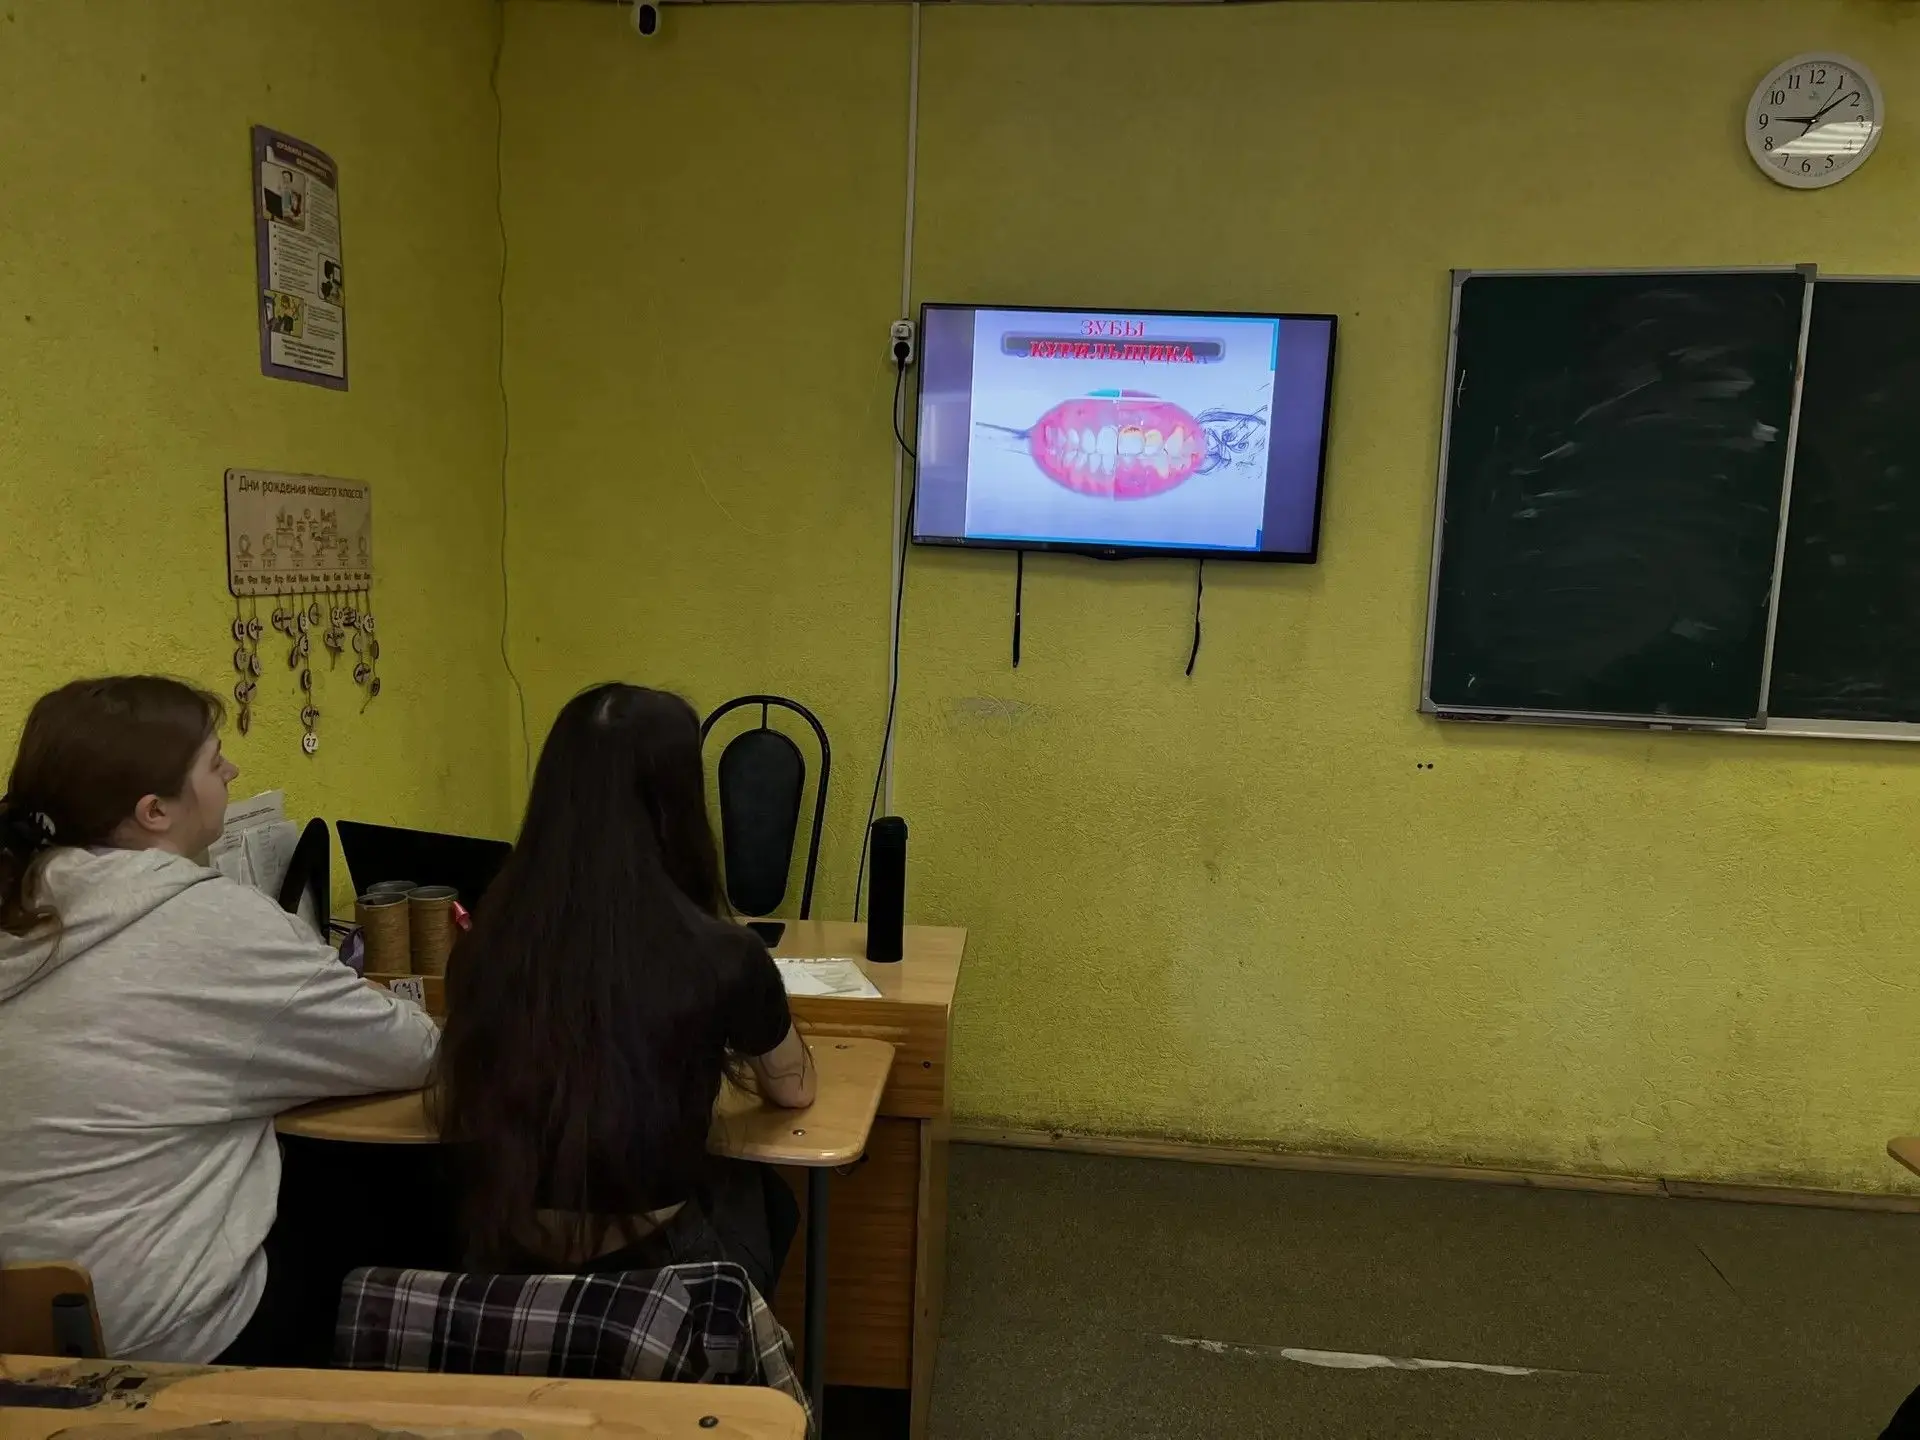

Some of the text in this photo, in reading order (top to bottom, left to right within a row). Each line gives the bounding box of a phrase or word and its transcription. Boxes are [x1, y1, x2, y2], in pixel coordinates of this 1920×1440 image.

[1788, 74, 1801, 90] 11
[1808, 69, 1826, 85] 12
[1838, 74, 1845, 90] 1
[1769, 90, 1786, 106] 10
[1849, 90, 1861, 107] 2
[1759, 113, 1769, 130] 9
[1764, 135, 1774, 151] 8
[1780, 152, 1790, 168] 7
[1801, 158, 1811, 173] 6
[1824, 154, 1835, 169] 5
[1080, 319, 1145, 337] ЗУБЫ
[1029, 340, 1198, 364] КУРИЛЬЩИКА
[239, 475, 364, 499] Дни рождения нашего класса
[306, 738, 317, 748] 27
